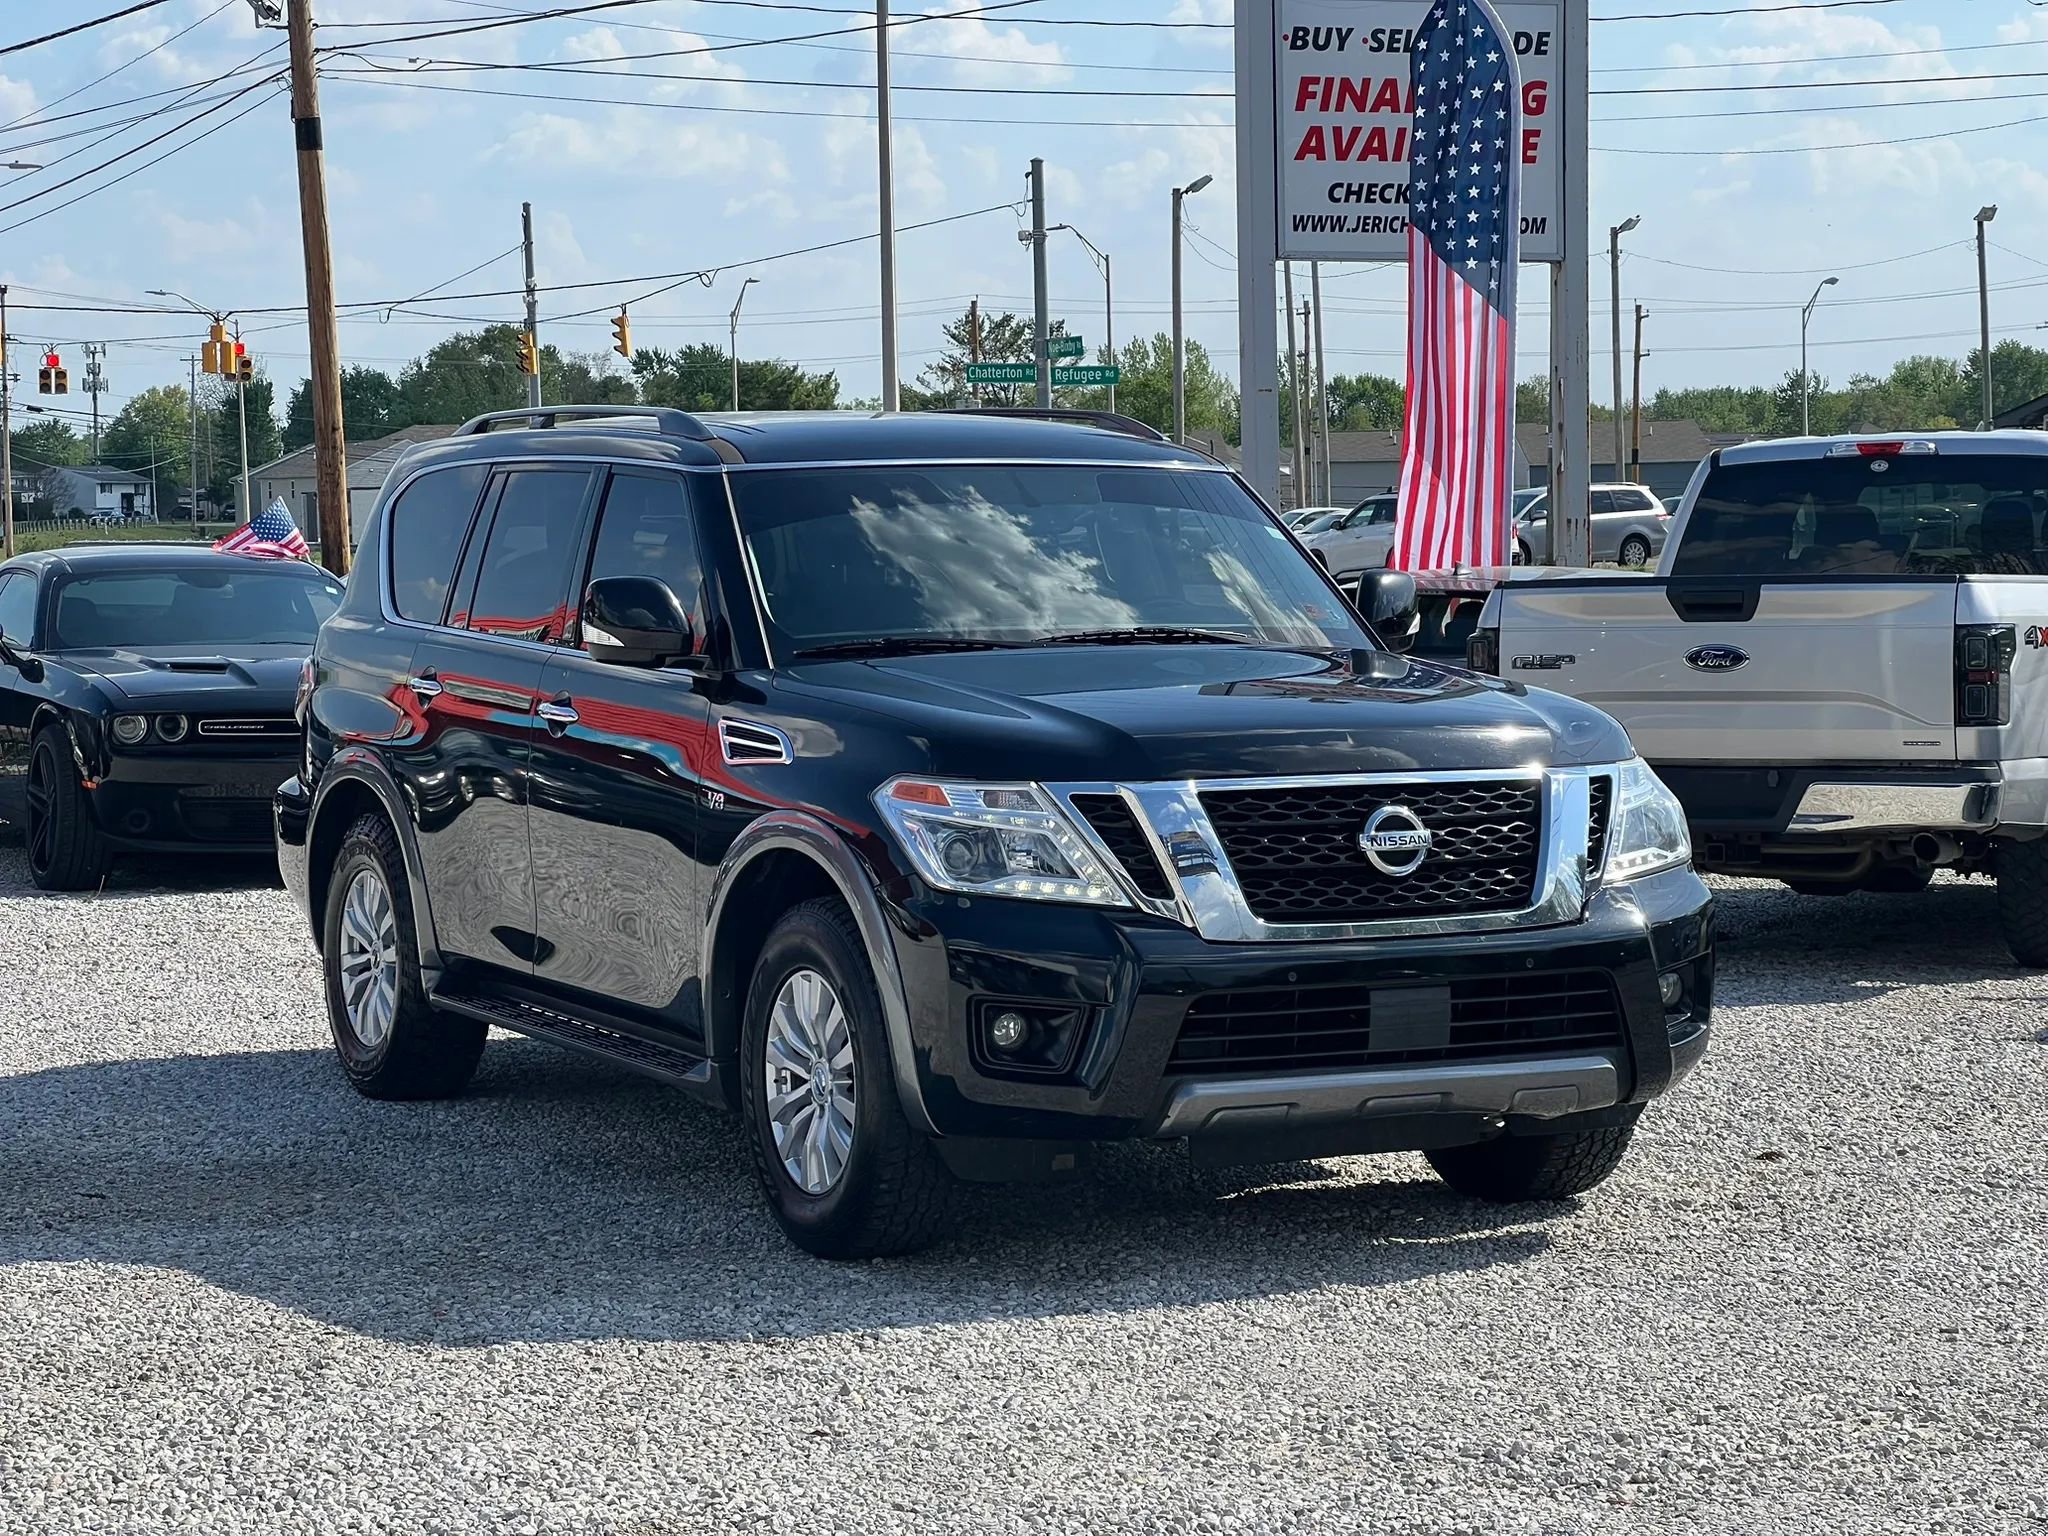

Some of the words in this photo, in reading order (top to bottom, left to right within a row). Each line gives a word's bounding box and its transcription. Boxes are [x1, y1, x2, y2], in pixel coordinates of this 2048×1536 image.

[1289, 26, 1354, 51] BUY
[1369, 28, 1413, 53] SEL
[1295, 76, 1548, 116] FINAG
[1293, 125, 1541, 164] AVAIE
[1327, 182, 1410, 204] CHECK
[968, 366, 1023, 379] Chatterton
[1025, 368, 1034, 376] Rd
[1055, 368, 1102, 384] Refugee
[1105, 369, 1114, 378] Rd
[1697, 650, 1734, 666] Ford
[1370, 833, 1428, 848] NISSAN
